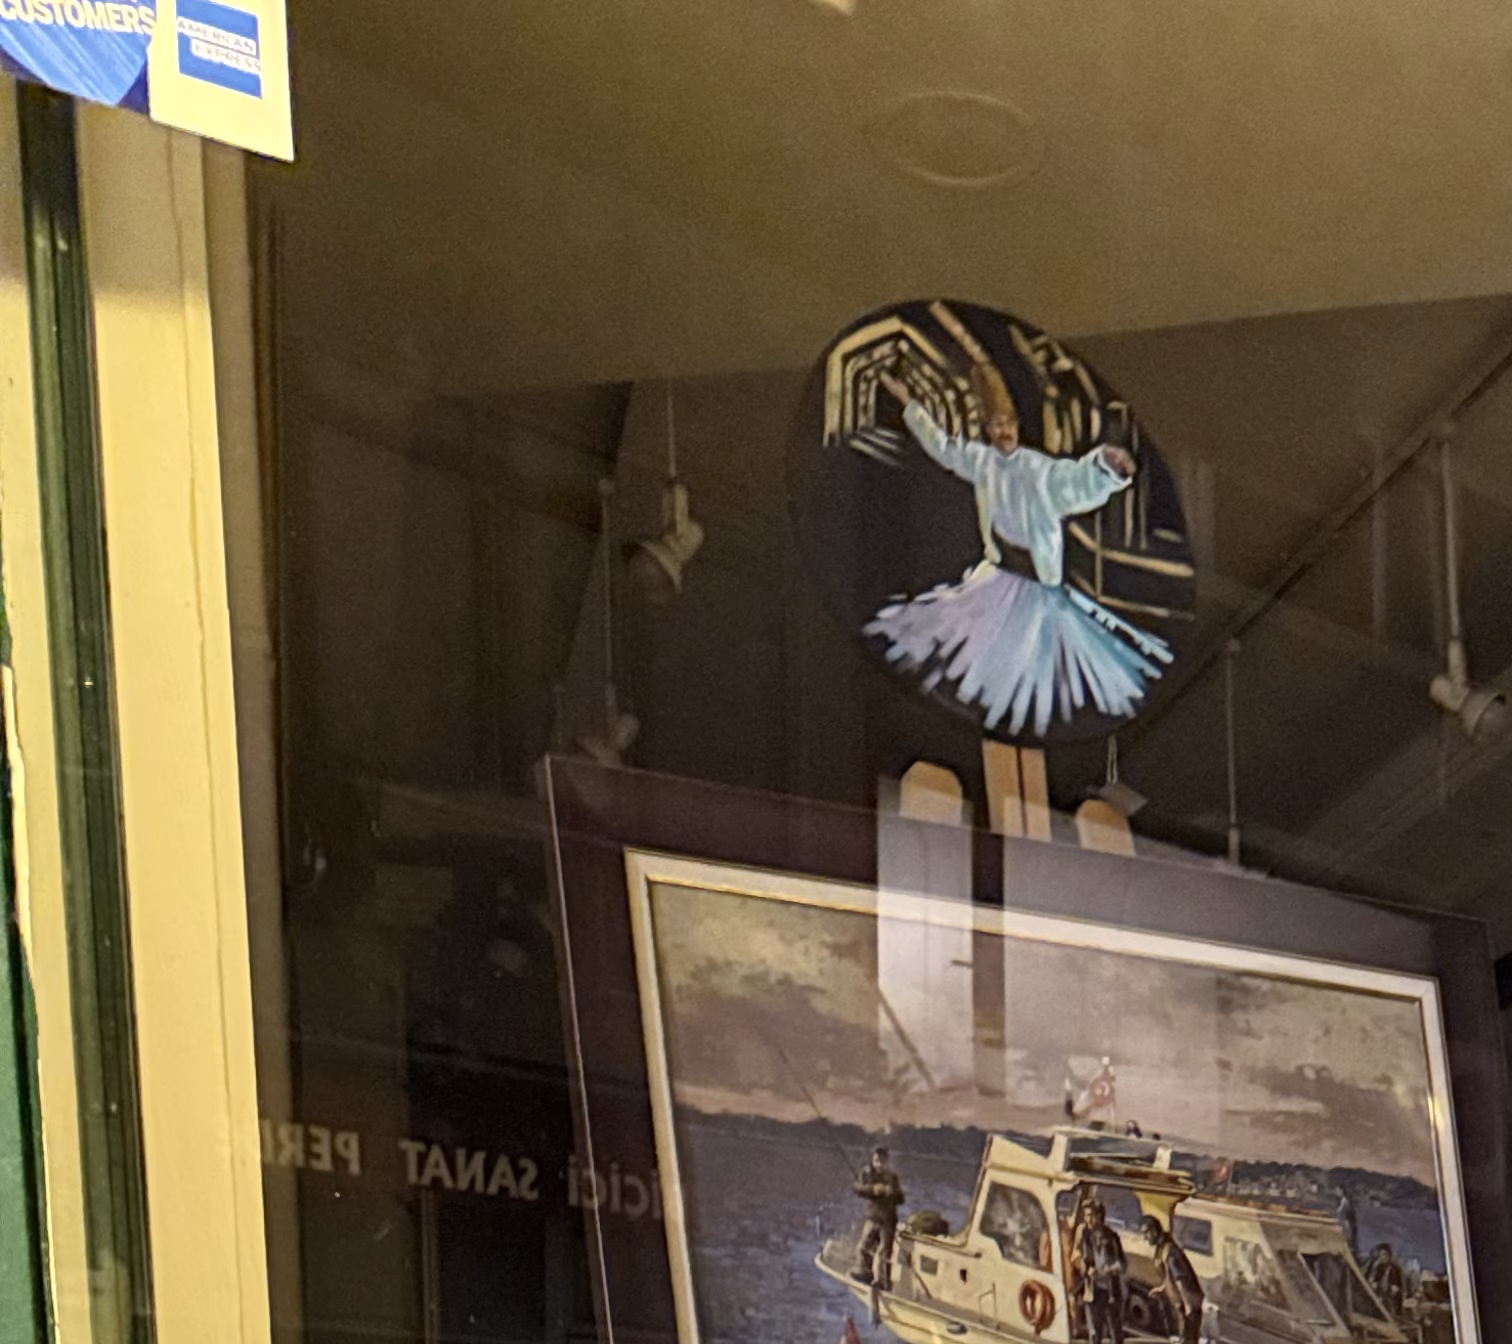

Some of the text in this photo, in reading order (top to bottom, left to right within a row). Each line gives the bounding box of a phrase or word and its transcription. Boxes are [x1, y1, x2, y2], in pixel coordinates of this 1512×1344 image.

[0, 0, 156, 35] CUSTOMERS
[177, 18, 256, 52] AMERICAN
[194, 43, 262, 73] EXPRESS
